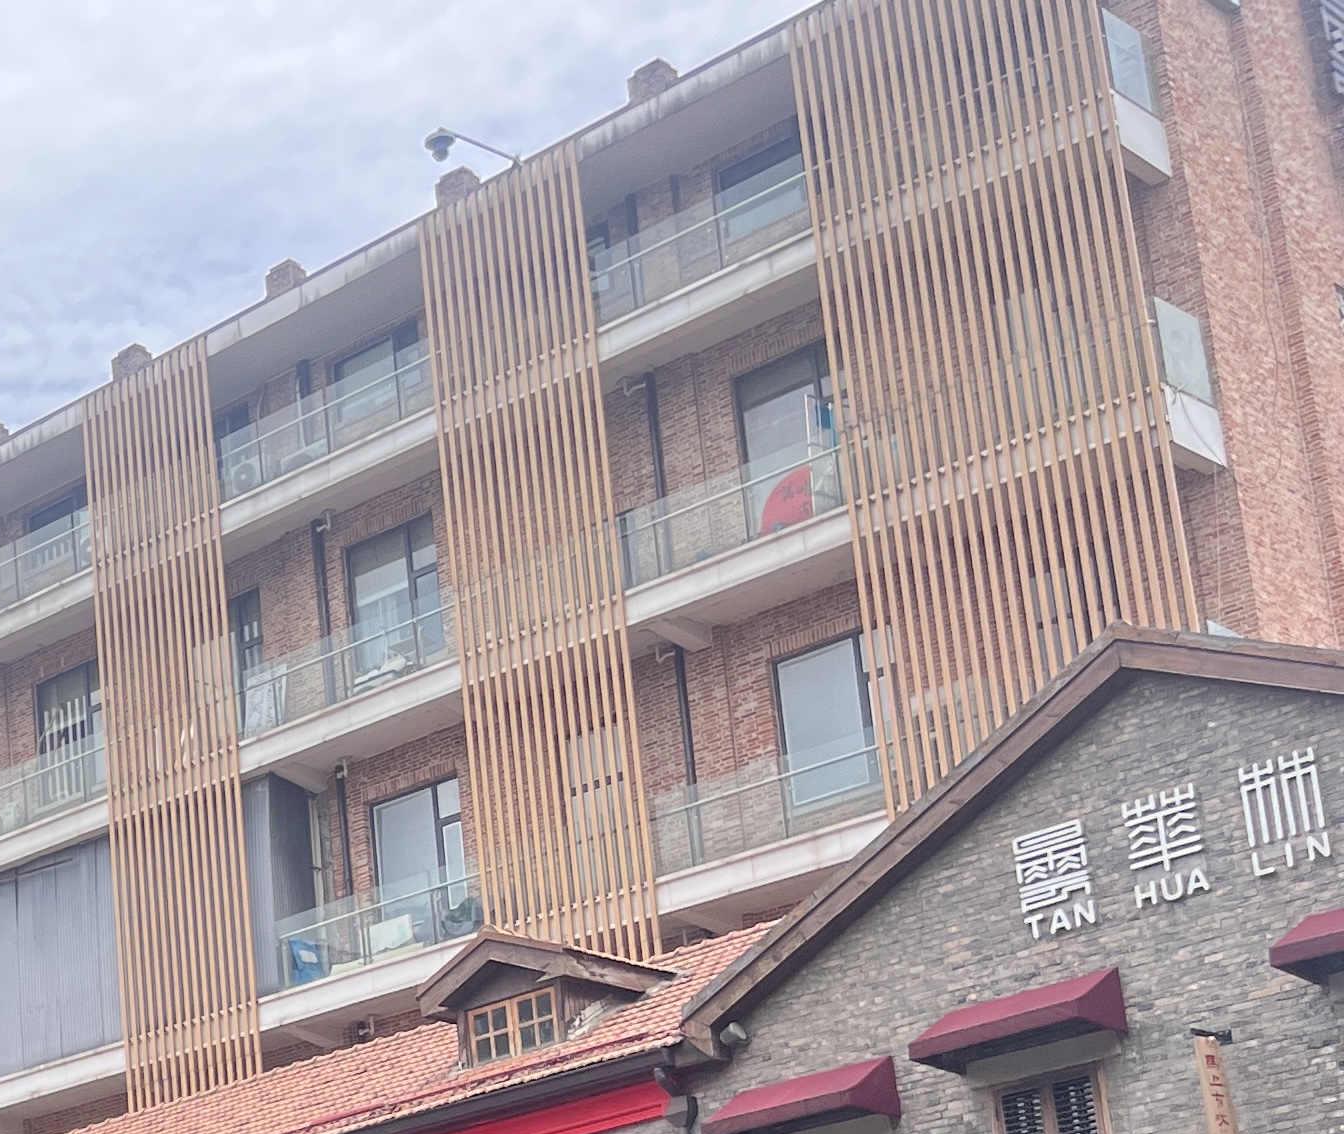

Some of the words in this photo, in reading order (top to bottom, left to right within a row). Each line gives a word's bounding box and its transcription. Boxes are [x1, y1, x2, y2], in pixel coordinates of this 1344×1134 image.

[1023, 899, 1097, 940] TAN
[1134, 867, 1211, 909] HUA
[1250, 831, 1332, 877] LIN
